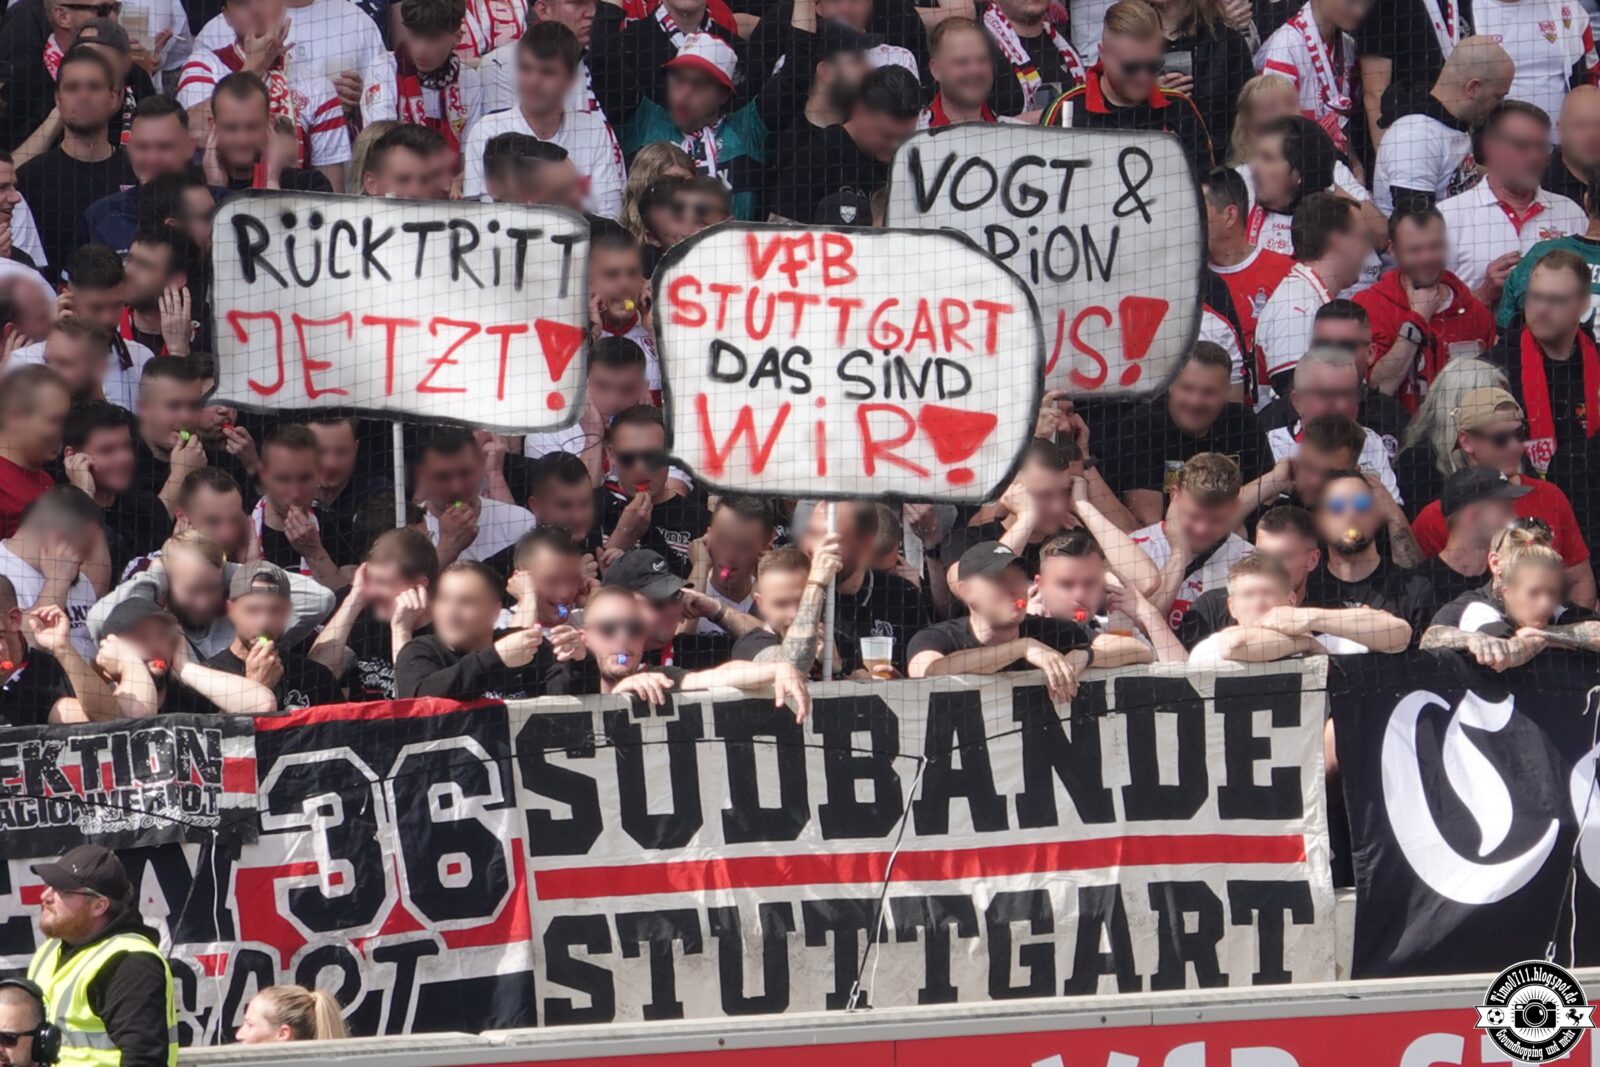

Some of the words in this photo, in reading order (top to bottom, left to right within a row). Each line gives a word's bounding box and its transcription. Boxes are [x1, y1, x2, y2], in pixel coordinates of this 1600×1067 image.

[908, 147, 1092, 218] VOGT
[1113, 147, 1156, 223] &
[226, 309, 587, 411] JETZT!
[667, 275, 1014, 357] STUTTGART
[708, 338, 813, 395] DAS
[515, 672, 1304, 857] SÜDBANDE
[258, 735, 516, 934] 36
[541, 879, 1315, 1026] STUTTGART
